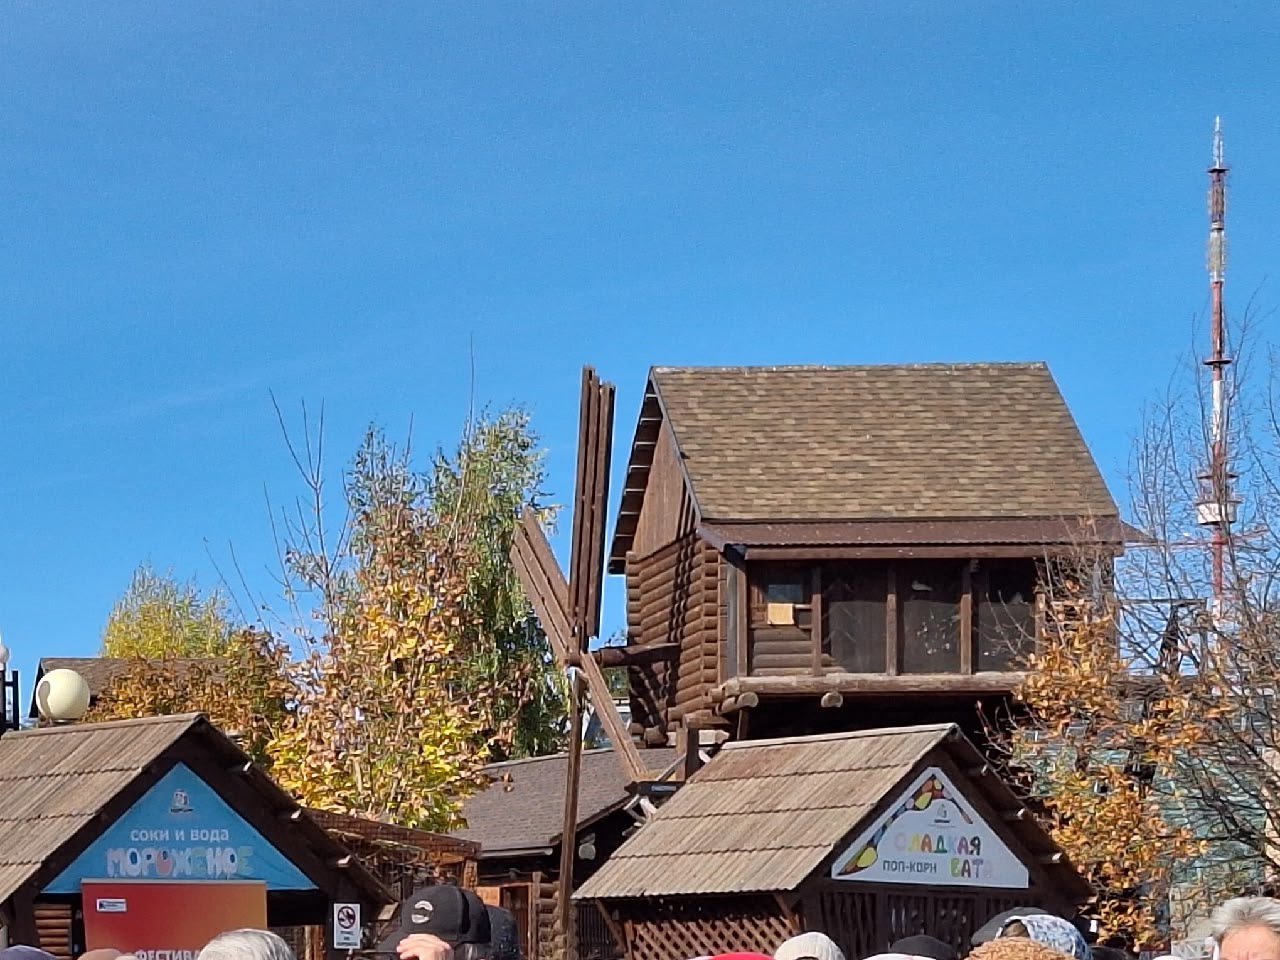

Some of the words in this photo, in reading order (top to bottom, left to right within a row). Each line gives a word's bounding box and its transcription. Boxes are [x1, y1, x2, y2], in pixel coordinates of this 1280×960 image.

[130, 829, 170, 841] соки
[175, 829, 185, 841] и
[190, 828, 230, 843] вода
[106, 847, 253, 878] МОРОЖЕНОЕ
[882, 859, 938, 874] ПОП-КОРН
